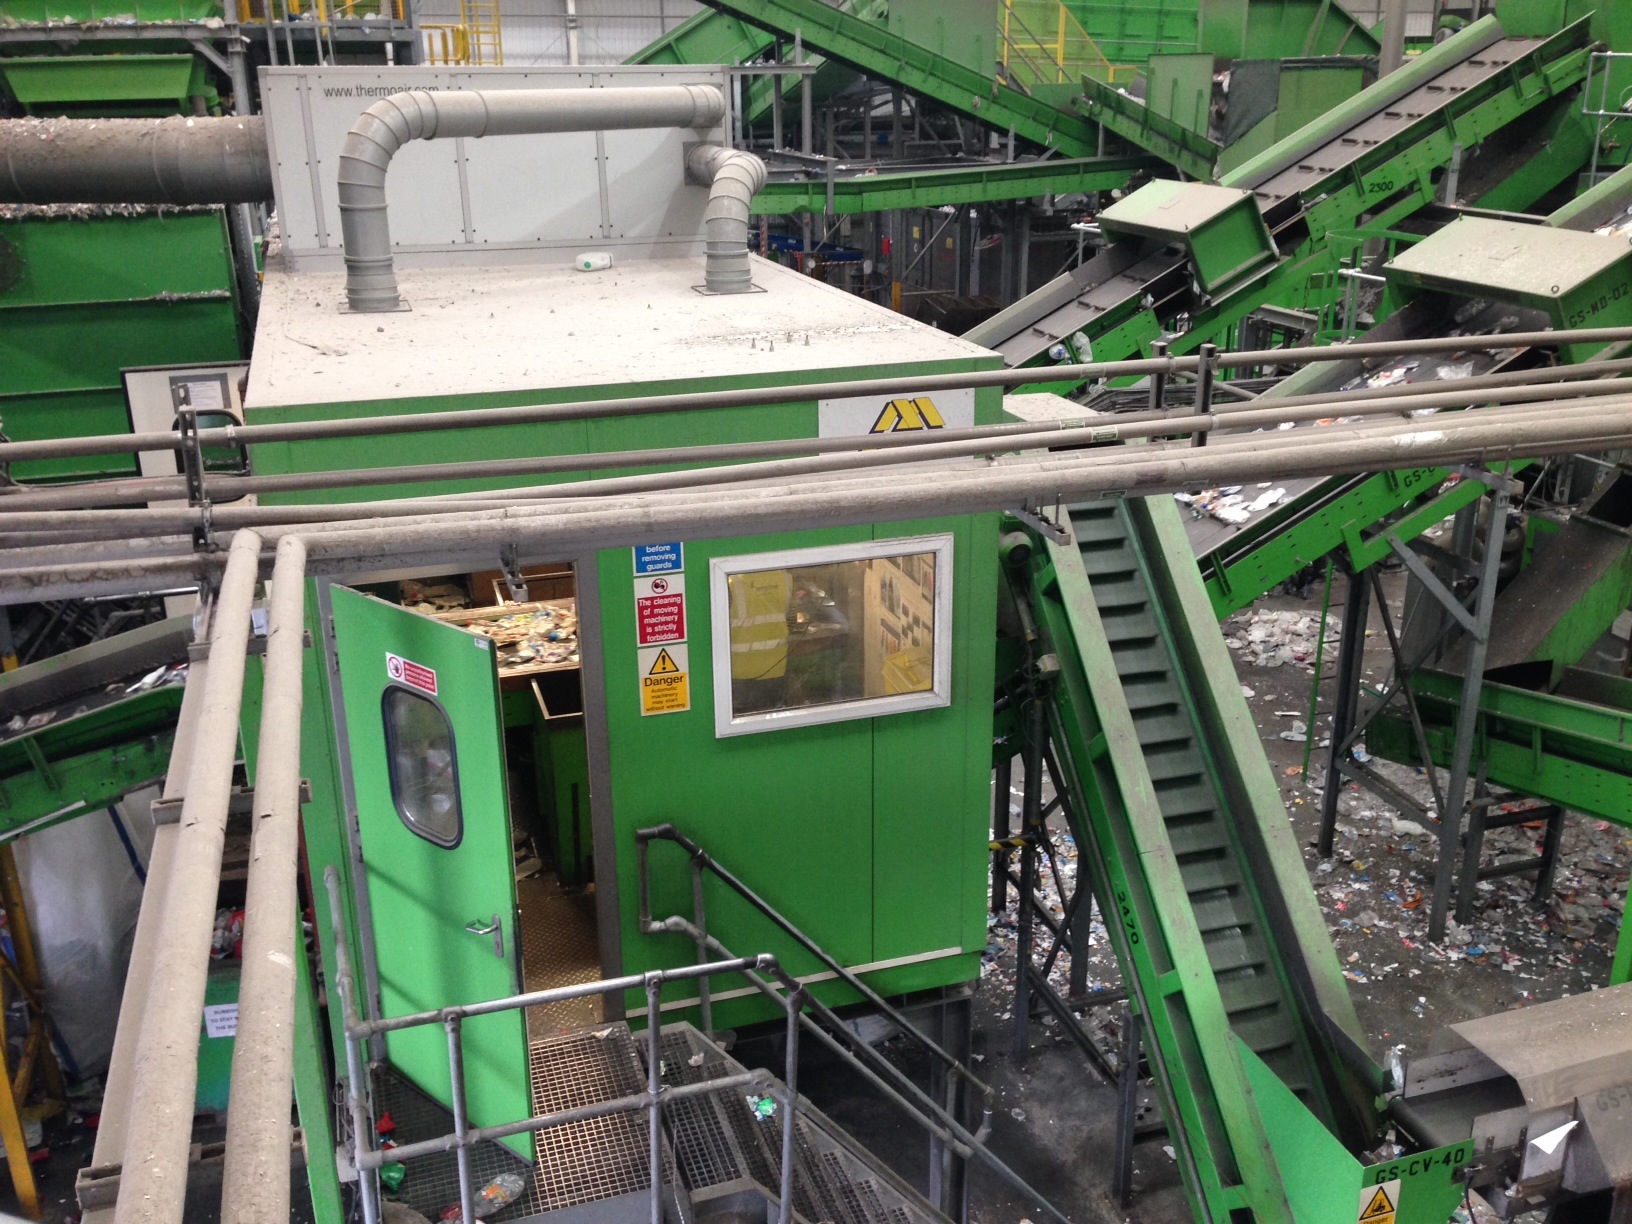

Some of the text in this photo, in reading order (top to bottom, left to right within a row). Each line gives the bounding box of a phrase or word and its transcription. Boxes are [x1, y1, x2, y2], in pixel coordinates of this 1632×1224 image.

[323, 84, 439, 97] www.thermoaircm
[1369, 180, 1394, 193] 2300
[1569, 282, 1629, 328] GS-MD-02
[646, 544, 671, 553] before
[641, 552, 676, 562] removing
[646, 561, 673, 571] guards
[638, 596, 682, 607] The cleaning
[643, 606, 678, 616] of moving
[643, 615, 679, 625] machinery
[654, 624, 677, 633] strictly
[646, 632, 679, 642] forbidden
[644, 675, 684, 687] Danger
[1117, 891, 1139, 945] 2470
[1376, 1148, 1465, 1185] GS-CV-40
